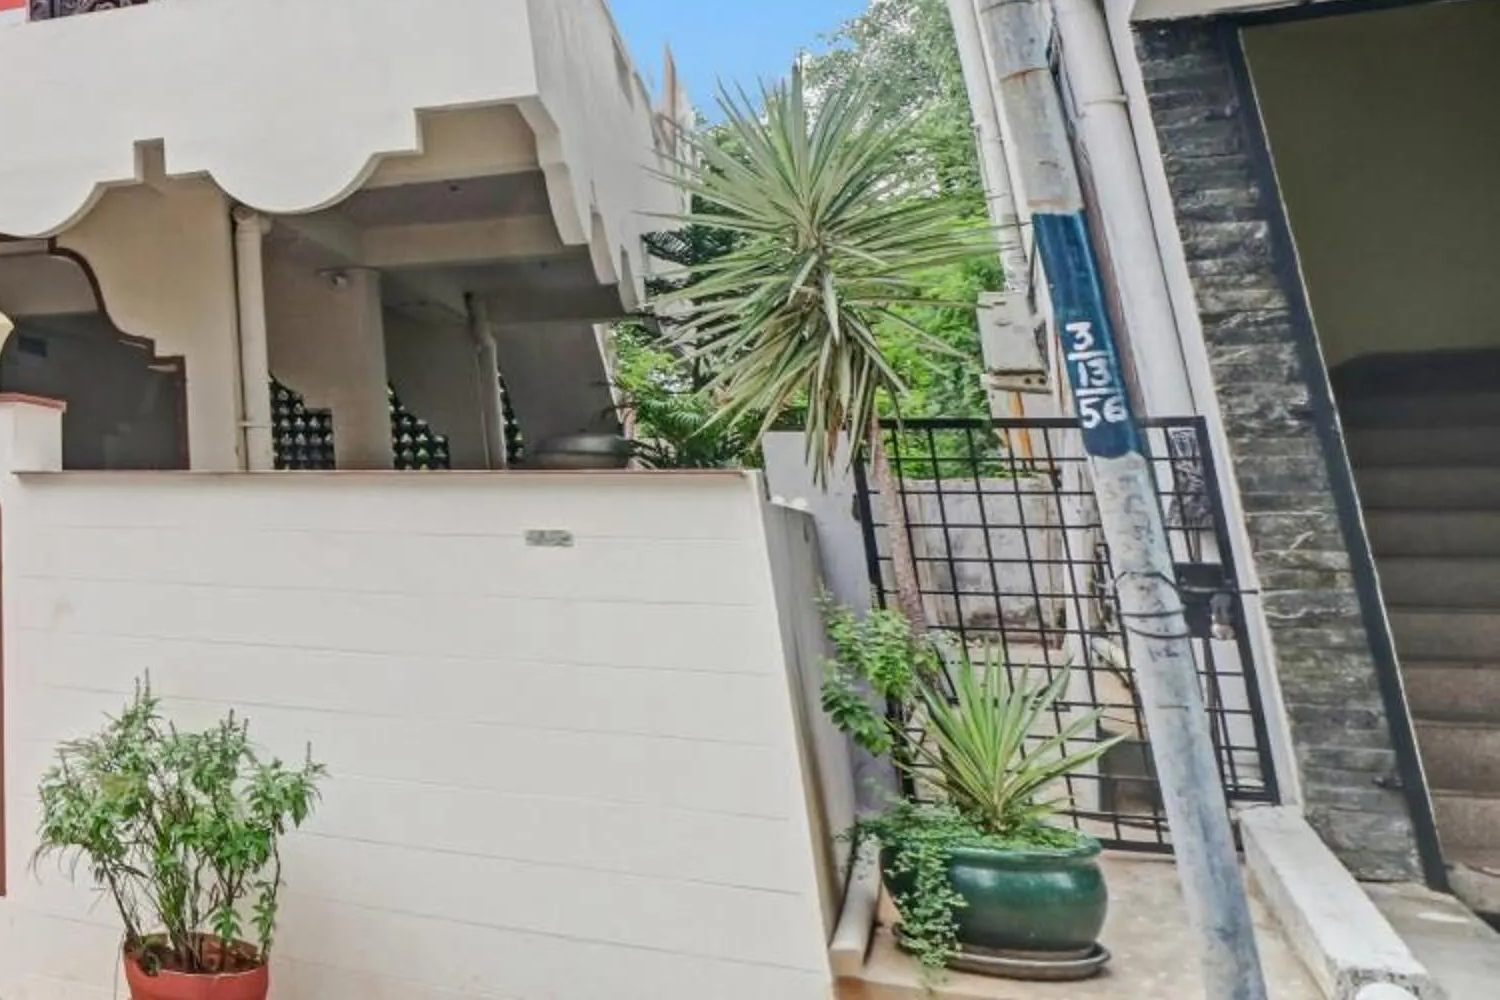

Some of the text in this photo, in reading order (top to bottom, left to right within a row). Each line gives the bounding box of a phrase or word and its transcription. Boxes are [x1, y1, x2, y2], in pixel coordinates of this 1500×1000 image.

[1065, 321, 1094, 351] 3
[1077, 359, 1111, 387] 13
[1079, 397, 1128, 429] 56
